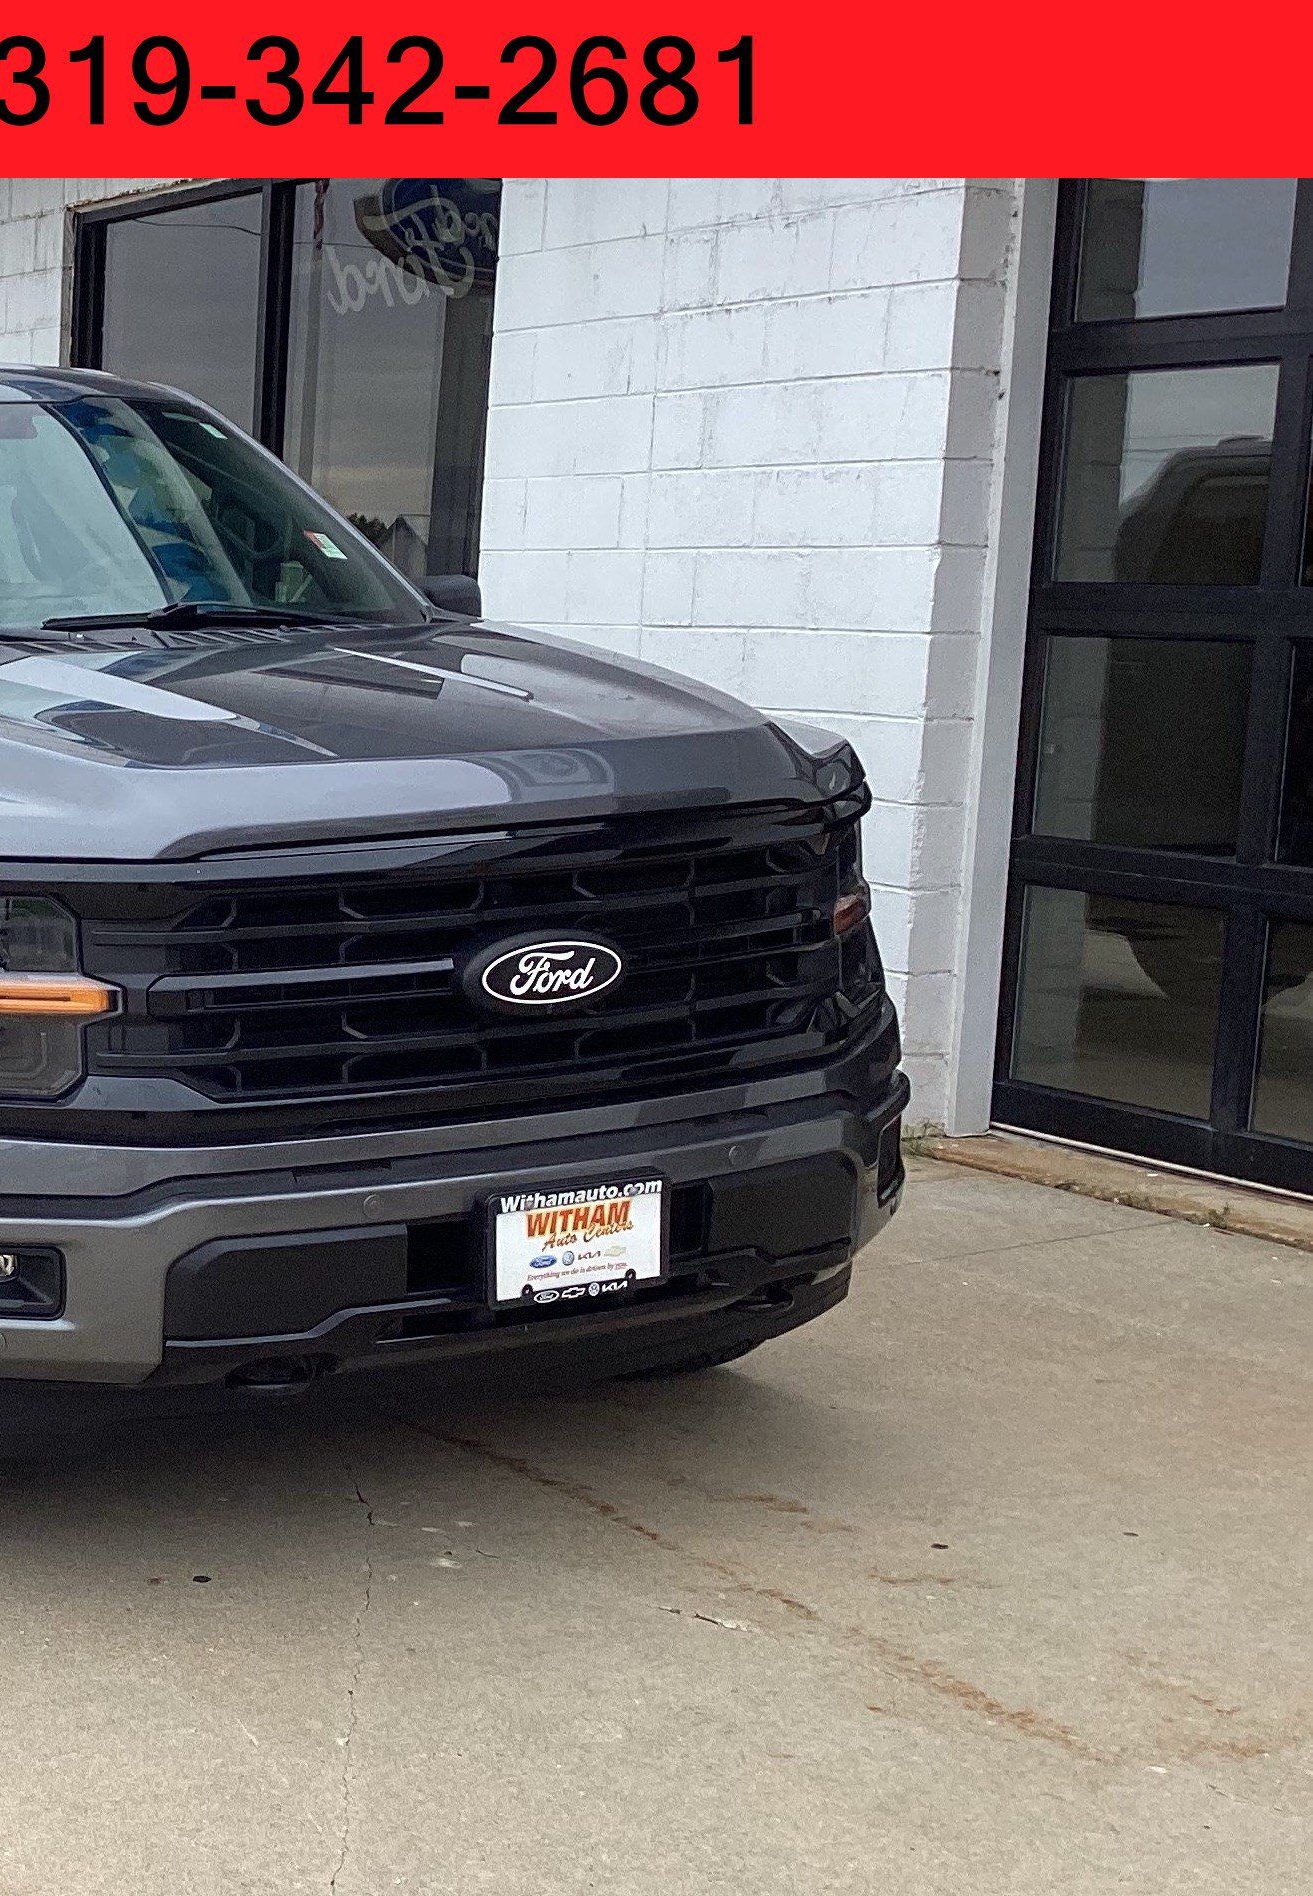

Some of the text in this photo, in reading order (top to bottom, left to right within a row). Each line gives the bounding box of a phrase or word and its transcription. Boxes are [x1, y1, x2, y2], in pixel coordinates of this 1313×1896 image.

[510, 951, 596, 995] Ford
[500, 1180, 663, 1213] Withamauto.com
[527, 1200, 631, 1237] WITHAM
[542, 1220, 634, 1252] Auto Centers
